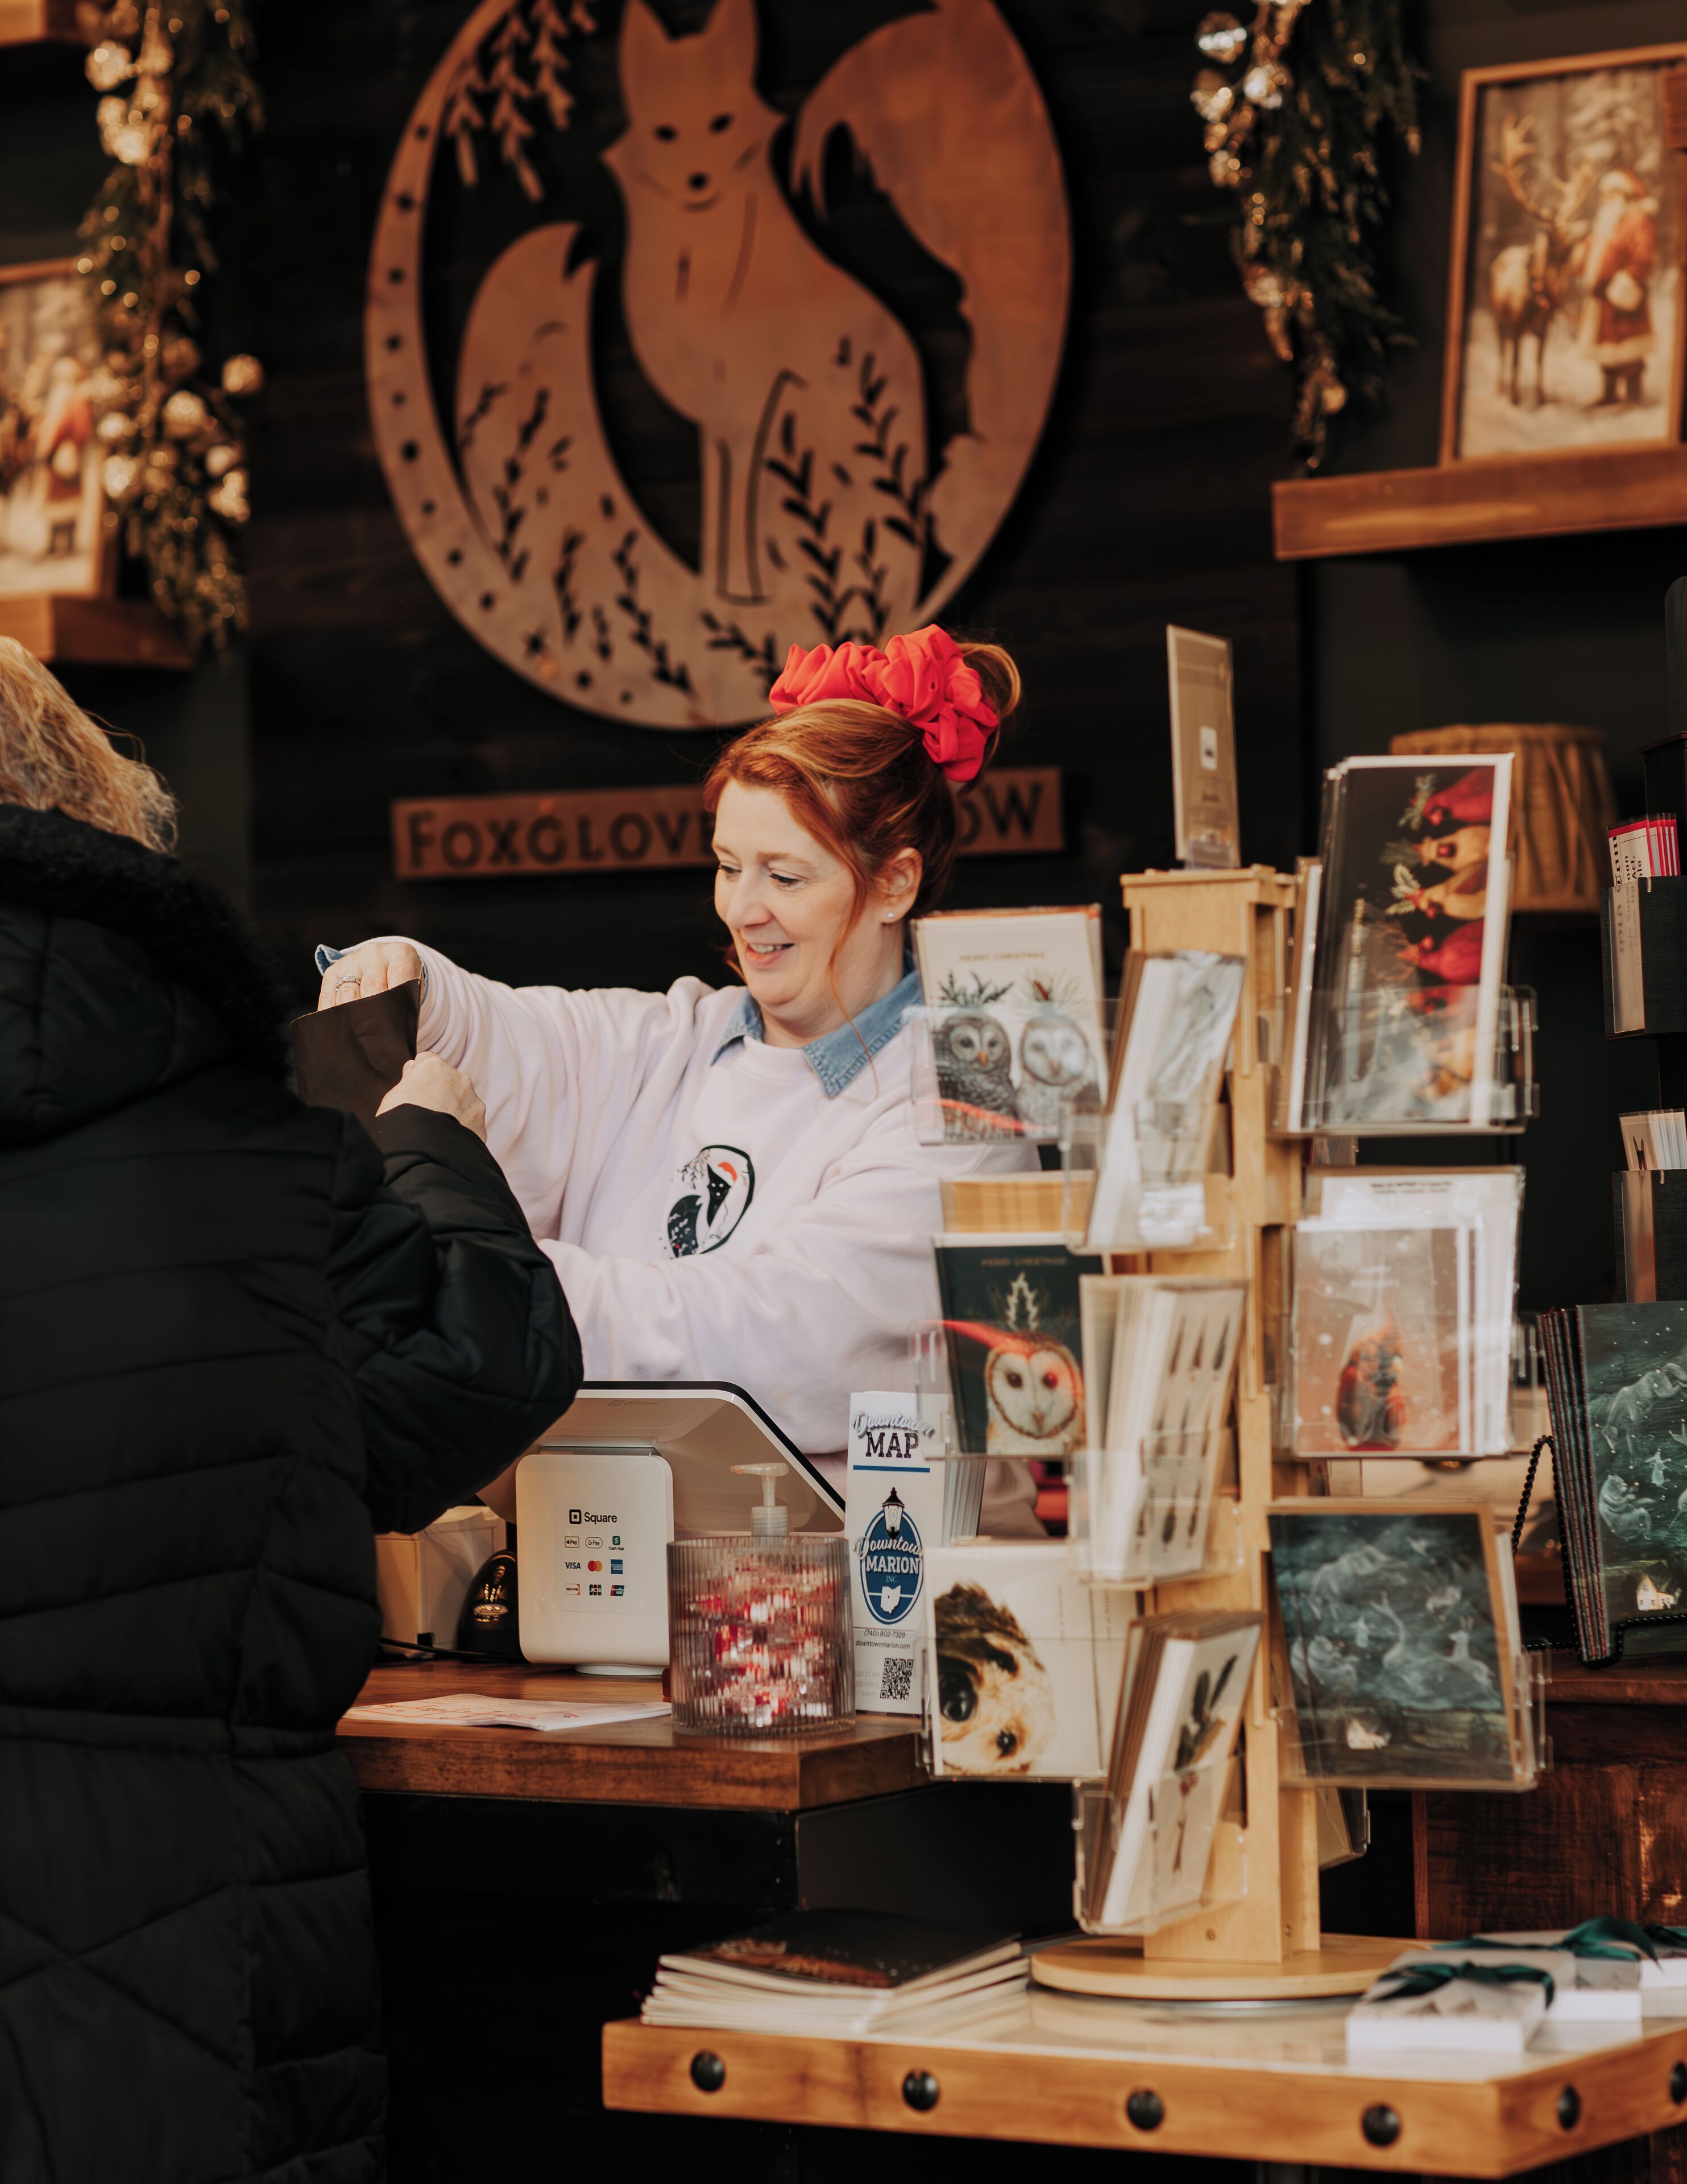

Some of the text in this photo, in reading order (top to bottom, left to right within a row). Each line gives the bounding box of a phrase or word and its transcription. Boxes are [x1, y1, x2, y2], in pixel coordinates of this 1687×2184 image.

[865, 1432, 919, 1458] MAP
[584, 1512, 617, 1525] Square
[852, 1535, 923, 1560] Downtow
[866, 1555, 920, 1574] MARION
[864, 1629, 905, 1639] (740) 802-7329
[855, 1640, 910, 1649] downtownmarion.com
